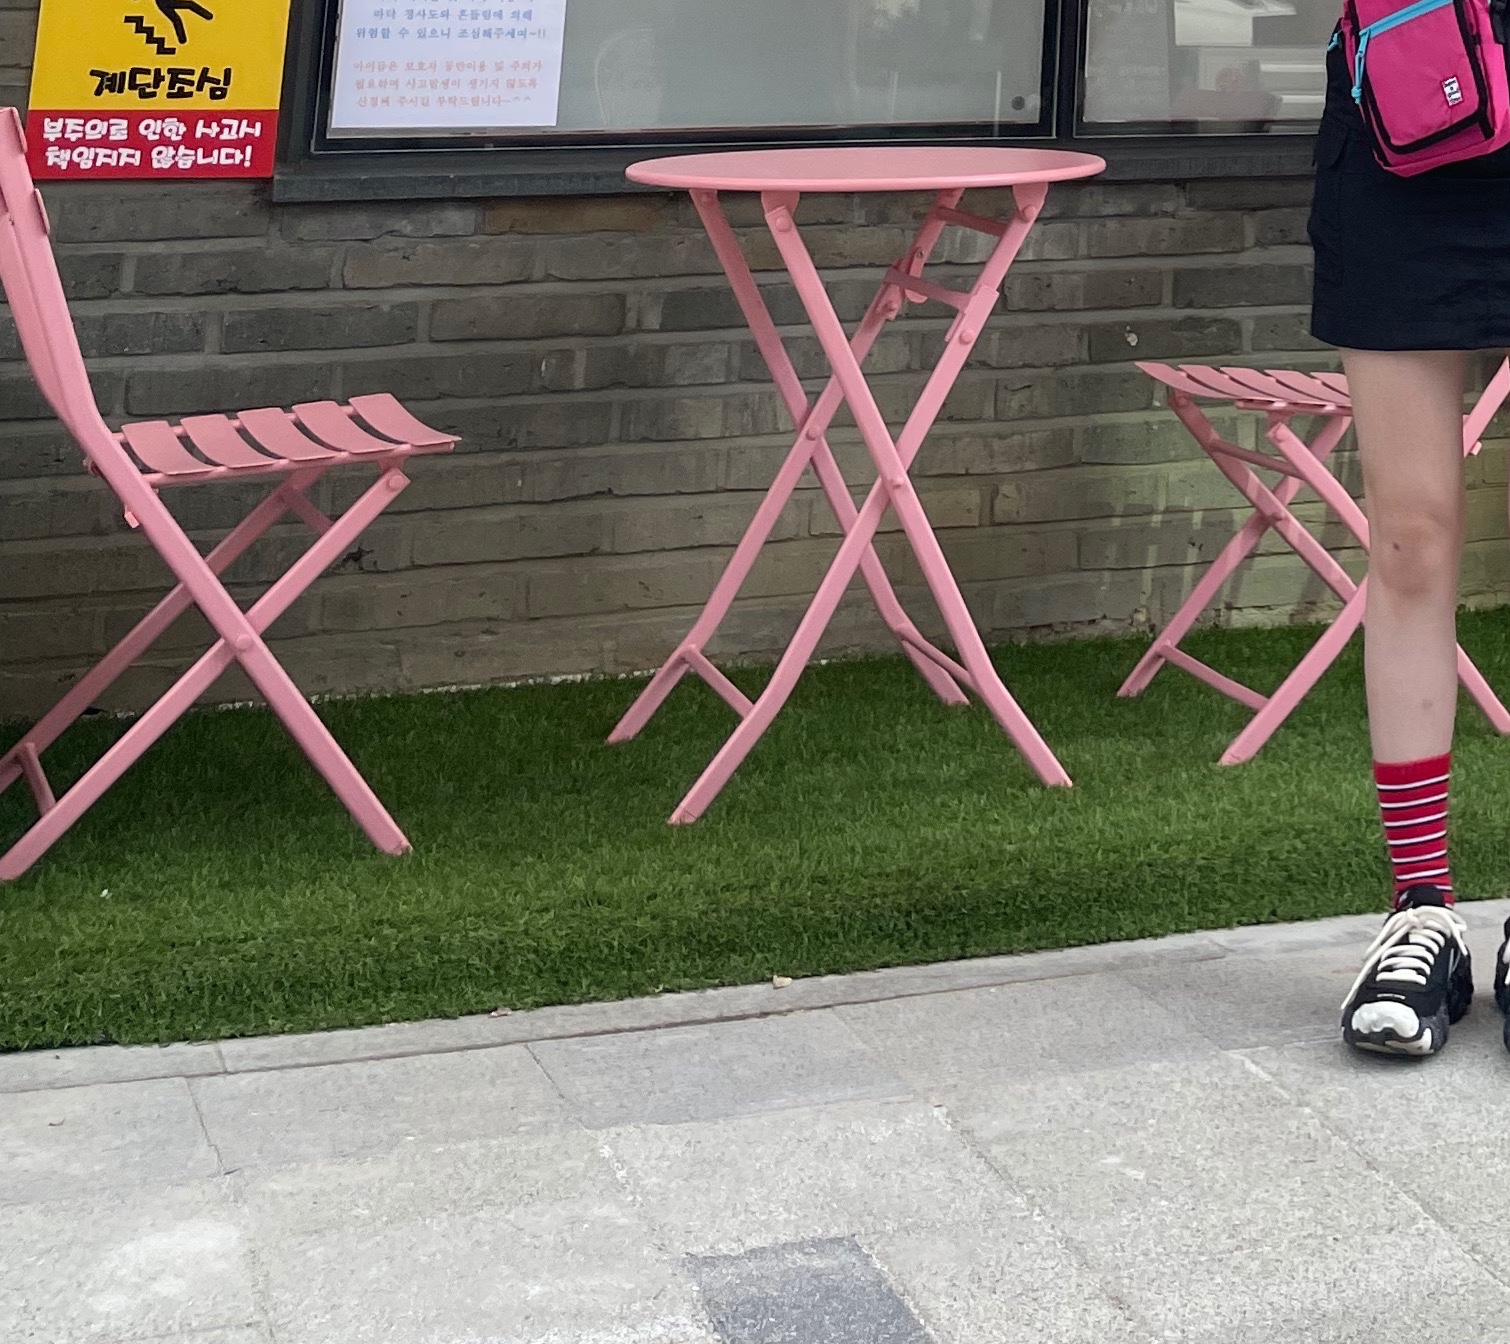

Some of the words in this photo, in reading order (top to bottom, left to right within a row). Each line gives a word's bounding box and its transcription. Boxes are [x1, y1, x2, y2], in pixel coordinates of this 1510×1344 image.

[405, 8, 450, 20] 경사도와
[457, 9, 503, 21] 흔들림에
[356, 27, 391, 39] 위험할
[398, 27, 410, 39] 수
[417, 27, 451, 39] 있으니
[89, 66, 232, 101] 계단조심
[42, 116, 129, 142] 부주의로
[138, 117, 187, 141] 인한
[195, 117, 262, 141] 사고시
[45, 145, 142, 170] 책임지지
[151, 144, 253, 170] 않습니다!
